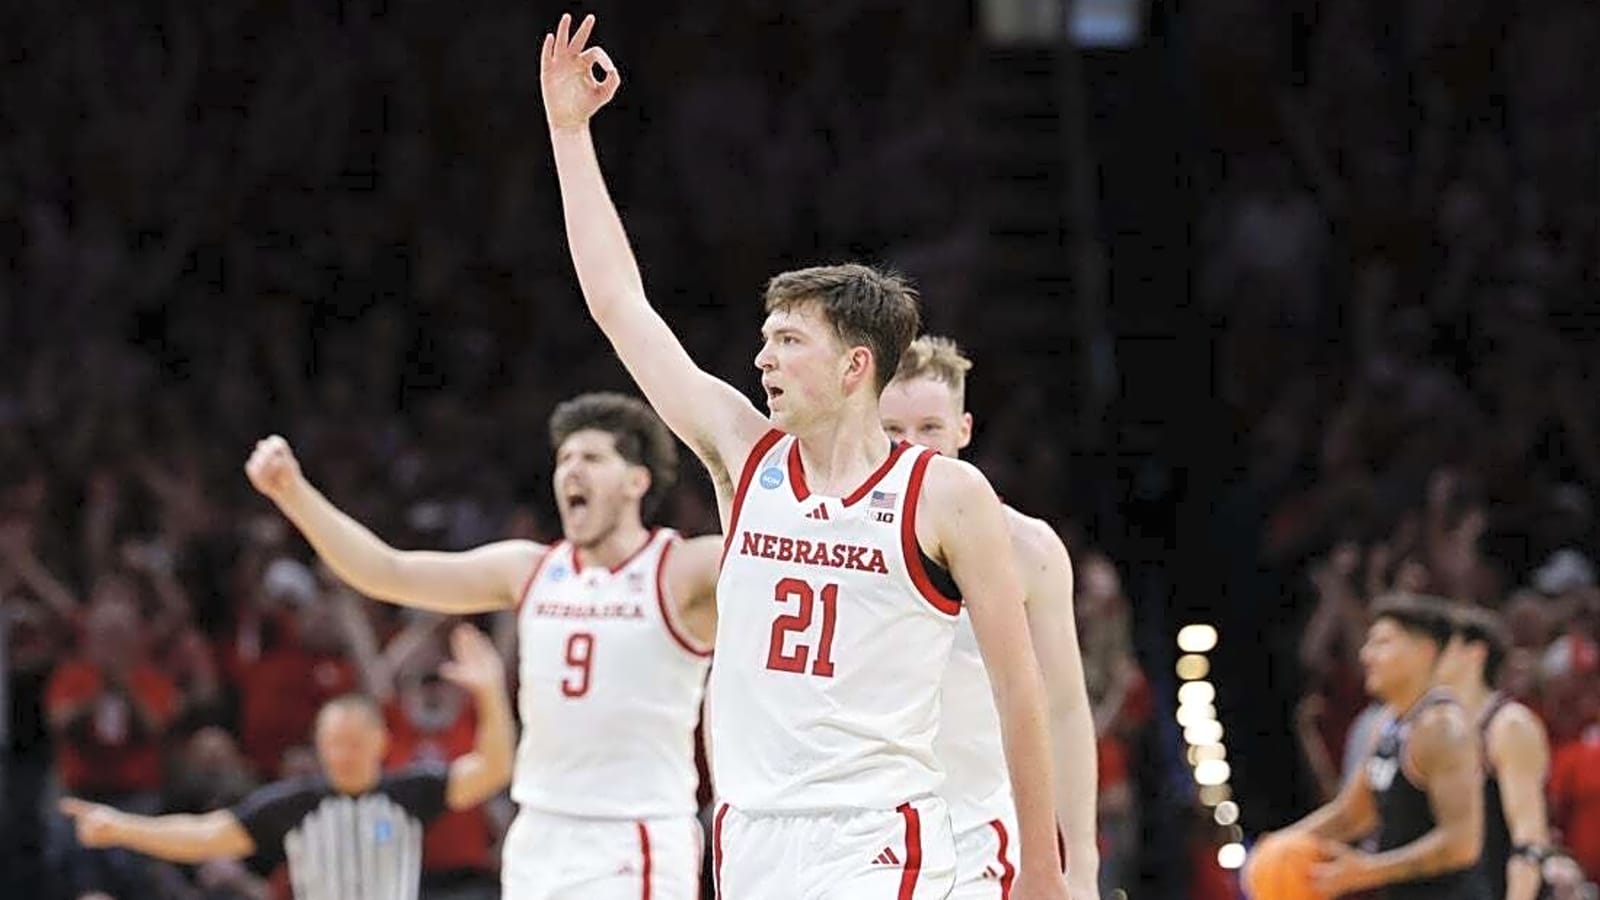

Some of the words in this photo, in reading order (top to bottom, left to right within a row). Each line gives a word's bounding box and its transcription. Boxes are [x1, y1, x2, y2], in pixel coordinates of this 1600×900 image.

[740, 531, 889, 574] NEBRASKA
[766, 577, 838, 678] 21
[562, 633, 593, 697] 9
